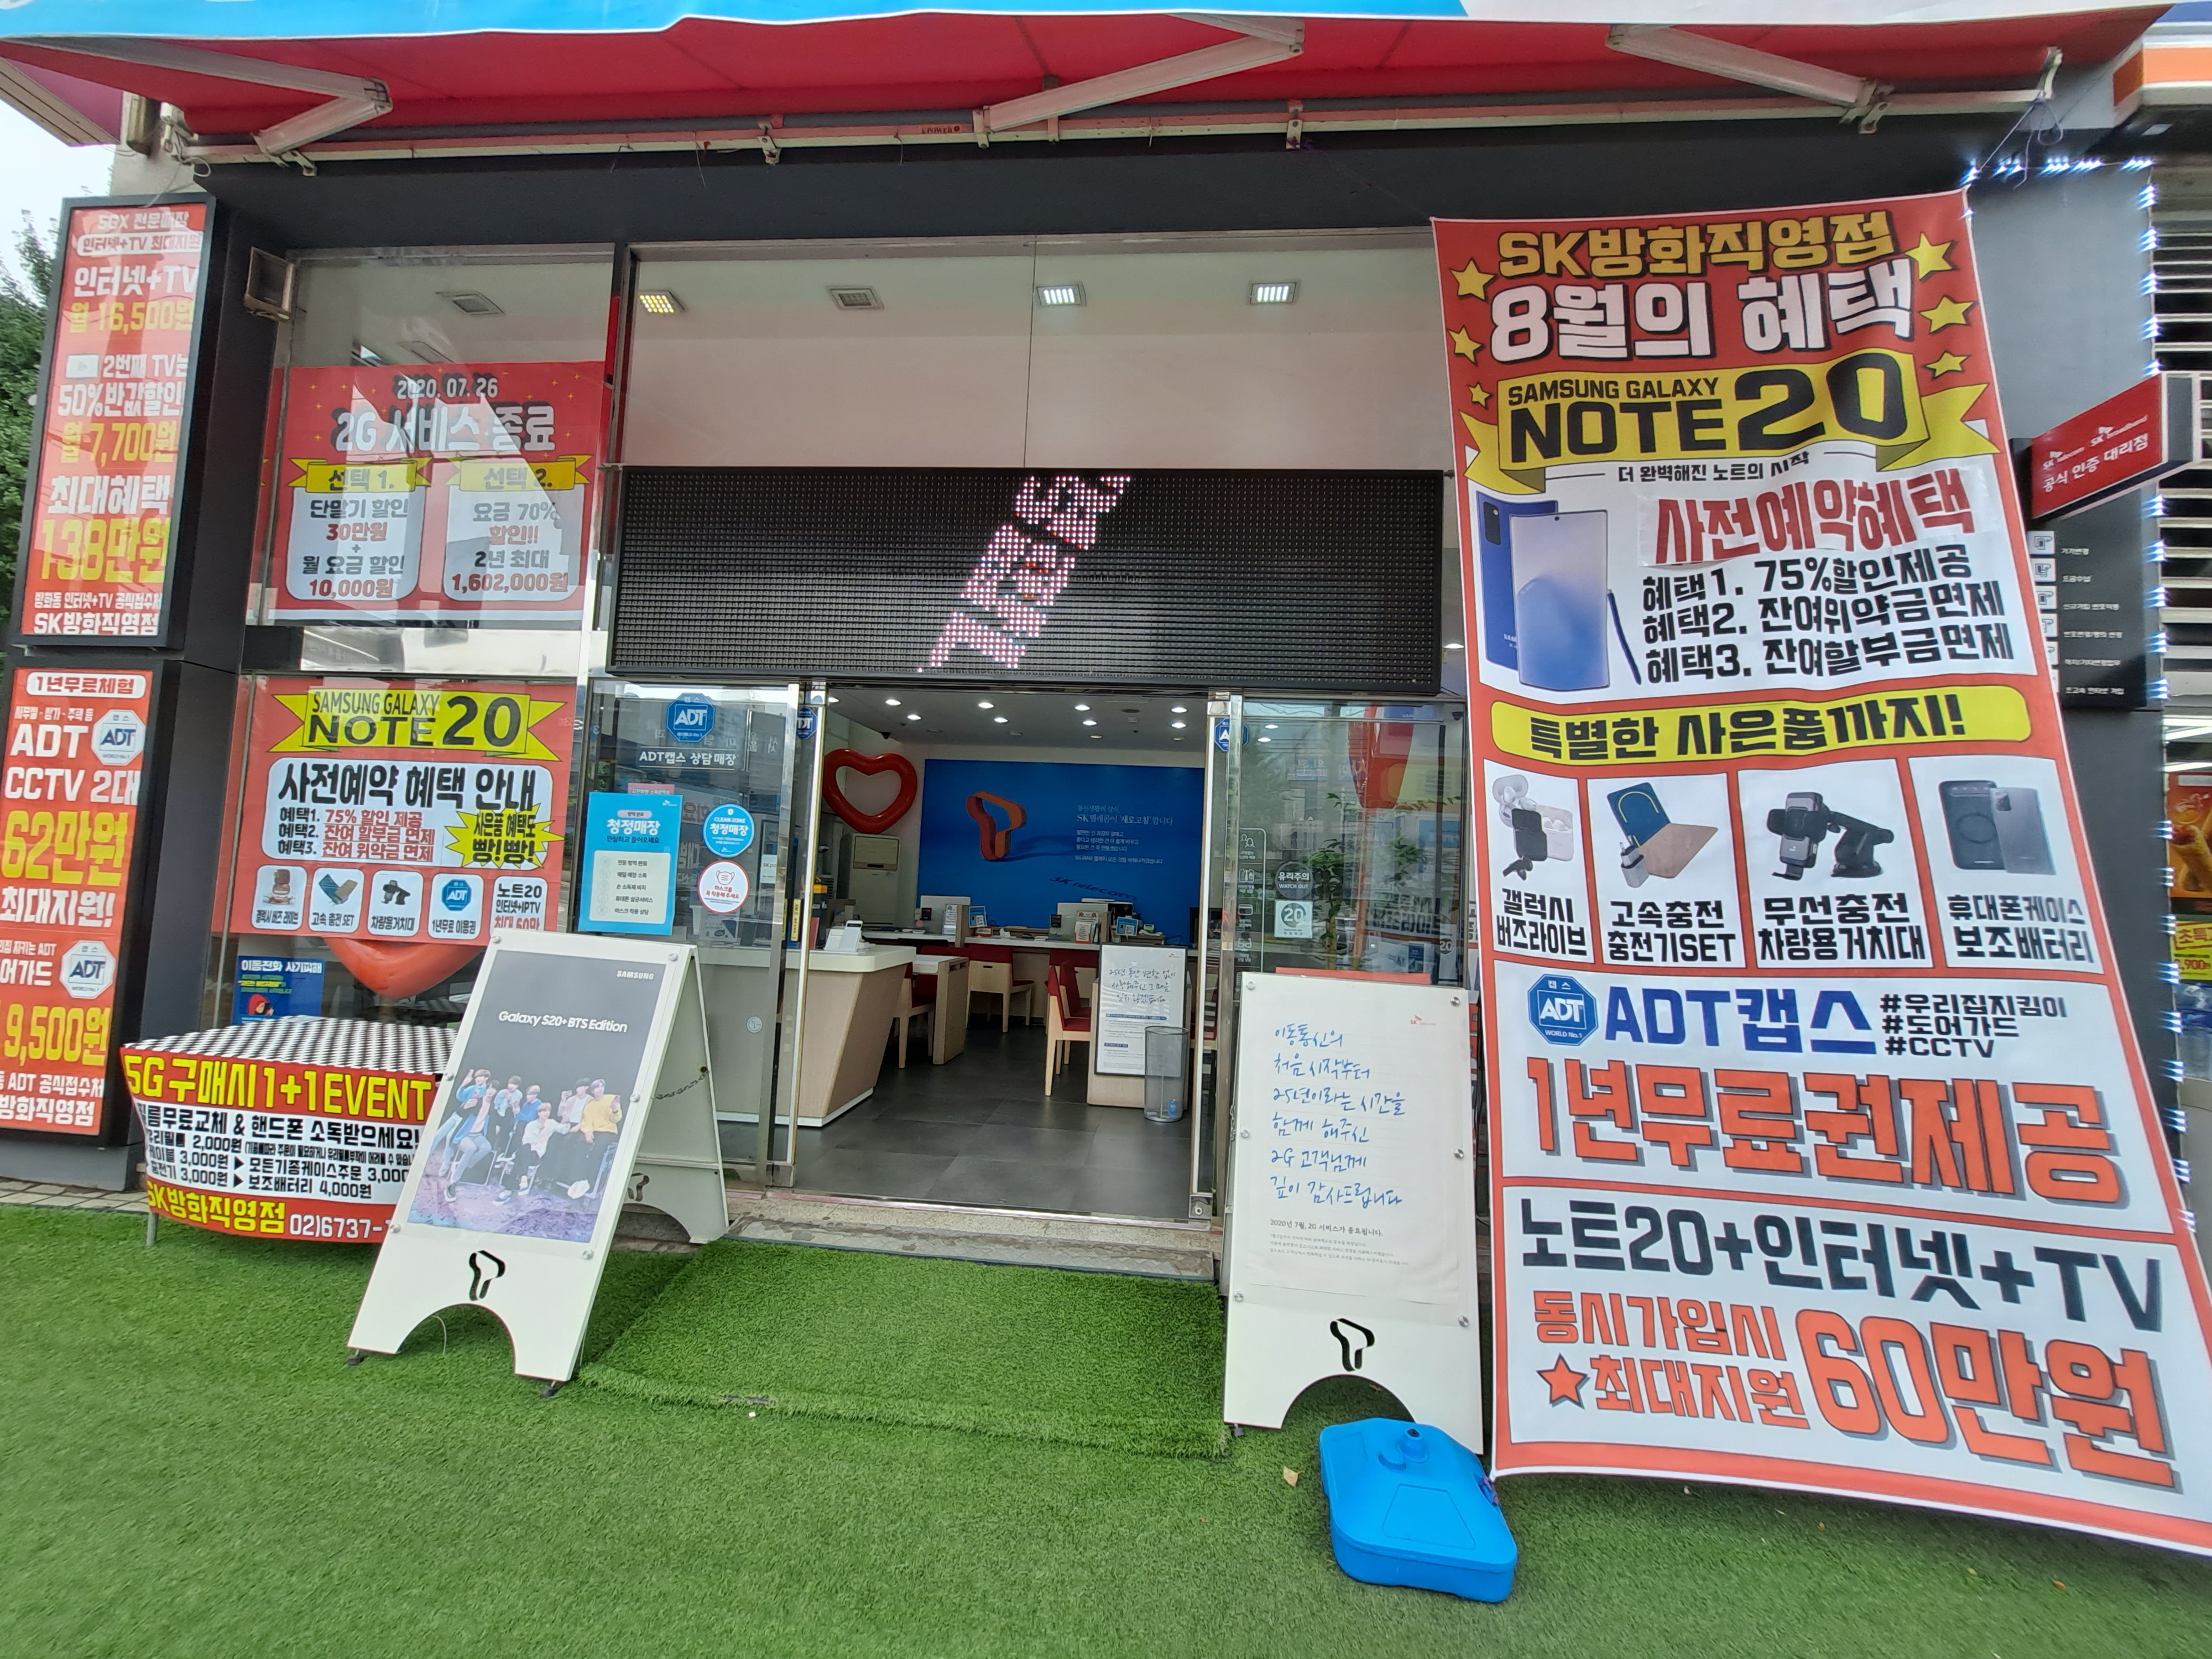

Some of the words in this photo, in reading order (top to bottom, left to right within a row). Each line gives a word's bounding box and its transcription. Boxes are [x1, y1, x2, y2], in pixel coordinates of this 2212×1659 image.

[1499, 210, 1896, 278] SK방화직영점
[74, 265, 198, 297] 인터넷+TV
[1490, 281, 1710, 362] 8월의
[1738, 259, 1913, 351] 혜택
[1508, 380, 1620, 406] SAMSUNG
[1626, 377, 1719, 399] GALAXY
[336, 410, 377, 452] 2G
[387, 406, 481, 452] 서비스
[492, 405, 555, 451] 종료
[1619, 467, 1635, 483] 더
[1640, 463, 1709, 483] 완벽해진
[1713, 462, 1764, 481] 노트의
[1770, 452, 1810, 478] 시작
[2043, 470, 2068, 493] 공식
[2072, 456, 2100, 479] 인증
[2104, 432, 2148, 461] 대리점
[328, 469, 370, 491] 선택
[378, 470, 395, 489] 1.
[484, 468, 528, 489] 선택
[534, 468, 552, 488] 2.
[48, 475, 171, 514] 최대혜택
[310, 500, 367, 519] 단말기
[371, 499, 409, 519] 할인
[473, 502, 511, 522] 요금
[518, 502, 559, 521] 70%
[1655, 467, 1974, 564] 사전예약혜택
[326, 523, 388, 542] 30만원
[489, 526, 539, 545] 할인!!
[41, 517, 171, 583] 138만원
[474, 550, 505, 569] 2년
[510, 550, 549, 569] 최대
[302, 556, 320, 575] 월
[326, 556, 362, 575] 요금
[369, 555, 405, 575] 할인
[309, 578, 394, 599] 10,000원
[452, 573, 568, 593] 1,602,000원
[34, 592, 62, 609] 방화동
[64, 592, 113, 609] 인터넷+TV
[33, 612, 159, 635] SK방화직영점
[36, 676, 134, 695] 1년무료체험
[312, 692, 380, 714] SAMSUNG
[383, 693, 440, 714] GALAXY
[675, 709, 707, 726] ADT
[1530, 715, 1658, 761] 특별한
[1677, 693, 1964, 756] 사은품까지!
[10, 724, 89, 759] ADT
[100, 728, 137, 747] ADT
[639, 751, 686, 764] ADT캡스
[4, 766, 86, 801] CCTV
[90, 770, 140, 805] 2대
[278, 762, 398, 807] 사전예약
[405, 765, 466, 809] 혜택
[475, 768, 536, 811] 안내
[279, 807, 320, 823] 혜택1.
[325, 810, 356, 824] 75%
[360, 810, 389, 827] 할인
[394, 811, 422, 828] 제공
[607, 818, 661, 836] 청정매장
[709, 823, 749, 836] 청정매장
[279, 823, 319, 839] 혜택2.
[324, 826, 354, 842] 잔여
[359, 826, 401, 843] 할부금
[405, 827, 435, 845] 면제
[2, 810, 128, 886] 62만원
[278, 839, 317, 855] 혜택3.
[322, 842, 353, 859] 잔여
[357, 843, 400, 860] 위약금
[404, 844, 433, 862] 면제
[1278, 872, 1310, 881] 유리주의
[447, 890, 467, 901] ADT
[497, 883, 542, 898] 노트20
[0, 886, 116, 928] 최대지원!
[496, 899, 541, 914] 인터넷+IPTV
[1502, 888, 1575, 924] 갤럭시
[1610, 900, 1724, 930] 고속충전
[1762, 893, 1911, 925] 무선충전
[1946, 894, 2086, 925] 휴대폰케이스
[1496, 916, 1586, 957] 버즈라이브
[1606, 931, 1735, 962] 충전기SET
[1759, 925, 1926, 961] 차량용거치대
[1954, 924, 2093, 964] 보조배터리
[69, 960, 106, 979] ADT
[242, 960, 283, 972] 이동전화
[285, 961, 322, 973] 사기피해
[617, 970, 654, 980] SAMSUNG
[1540, 997, 1583, 1022] ADT
[1879, 993, 2067, 1019] #우리집지킴이
[498, 1010, 540, 1029] Galaxy
[541, 1015, 567, 1029] S20+
[567, 1018, 588, 1029] BTS
[588, 1019, 628, 1033] Edition
[1604, 984, 1877, 1056] ADT캡스
[1881, 1015, 2019, 1039] #도어가드
[4, 1003, 111, 1067] 9,500원
[1275, 1023, 1343, 1048] 이동통신의
[1545, 1029, 1567, 1037] WORLD
[1885, 1037, 1995, 1060] #CCTV
[1274, 1053, 1306, 1077] 처음
[1310, 1058, 1370, 1081] 시작부터
[1274, 1087, 1355, 1112] 25년이라는
[1361, 1092, 1406, 1116] 시간을
[1272, 1112, 1313, 1137] 함께
[1322, 1118, 1370, 1144] 해주신
[1527, 1056, 2121, 1204] 1년무료권제공
[1272, 1149, 1295, 1165] 2G
[1301, 1150, 1366, 1172] 고객님께
[180, 1168, 228, 1187] 3,000원
[249, 1175, 312, 1194] 보조배터리
[320, 1182, 372, 1199] 4,000원
[1270, 1177, 1300, 1199] 깊이
[1307, 1180, 1403, 1209] 감사드립니다
[1270, 1219, 1292, 1228] 2020년
[1521, 1197, 2164, 1334] 노트20+인터넷+TV
[1533, 1289, 1787, 1362] 동시가입시
[1589, 1355, 1812, 1430] 최대지원
[1794, 1308, 2176, 1488] 60만원
